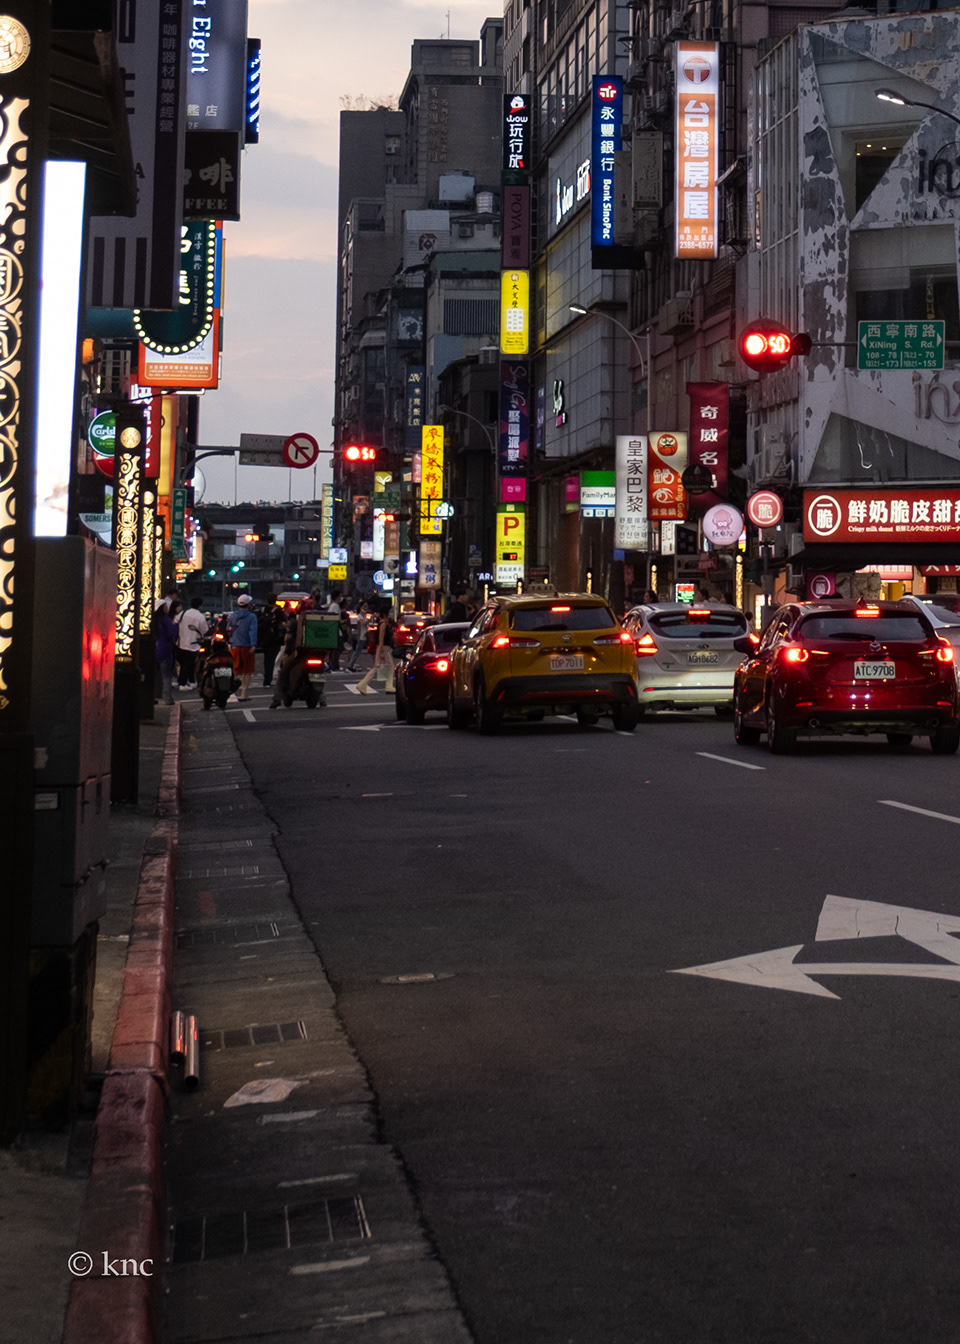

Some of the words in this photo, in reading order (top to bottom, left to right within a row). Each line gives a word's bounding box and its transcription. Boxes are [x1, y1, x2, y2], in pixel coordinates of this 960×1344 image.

[189, 16, 212, 74] Eight
[159, 23, 178, 133] 咖啡器材專業經營
[509, 123, 524, 168] 玩行旅
[601, 107, 614, 171] 永豐銀行
[684, 100, 709, 219] 台灣房屋
[185, 198, 228, 210] FFEE
[603, 179, 612, 201] Bank
[511, 193, 522, 231] POYA
[603, 203, 611, 239] SinoPac
[901, 210, 940, 220] HAIR
[680, 241, 713, 249] 2388-6577
[868, 324, 935, 338] 西寧南路
[869, 341, 897, 350] XiNing
[699, 405, 718, 489] 奇威名
[627, 440, 643, 512] 皇家巴黎
[582, 491, 616, 499] FamilyMar
[504, 517, 520, 536] P
